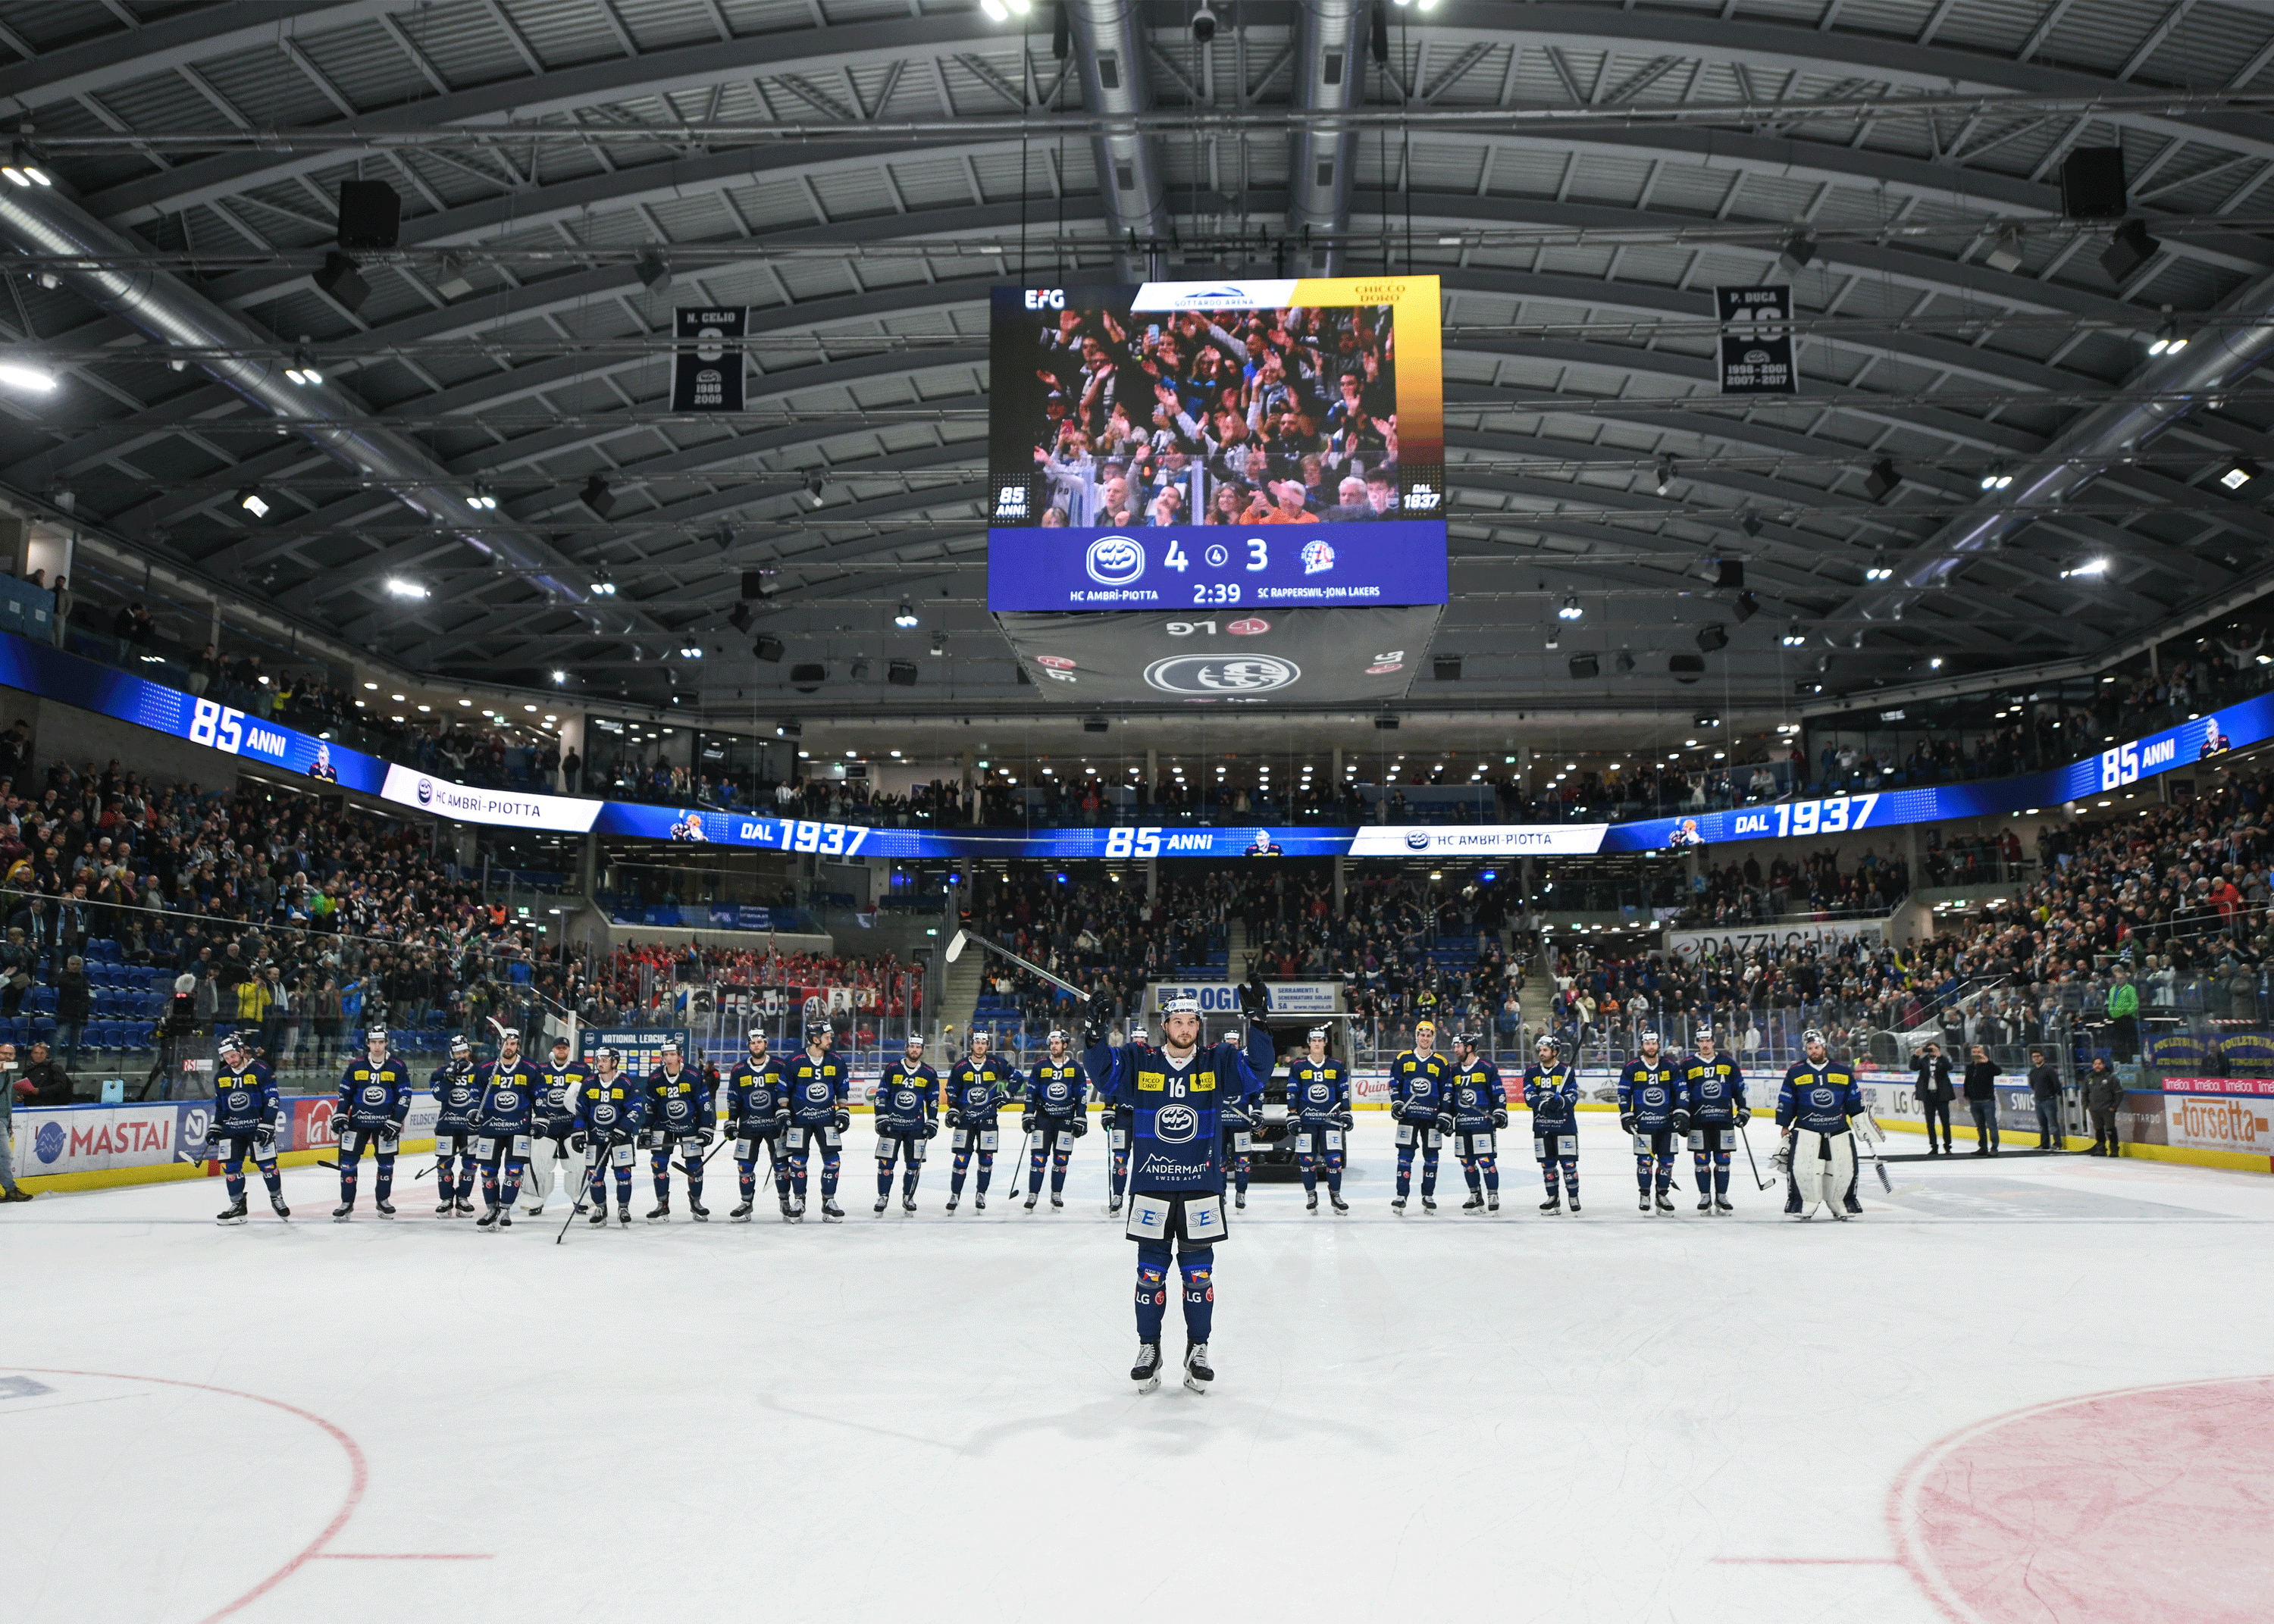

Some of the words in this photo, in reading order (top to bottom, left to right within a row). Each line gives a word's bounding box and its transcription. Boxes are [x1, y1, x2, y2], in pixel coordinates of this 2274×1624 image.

[1025, 289, 1065, 309] EFG
[1225, 298, 1254, 306] ARENA
[1731, 292, 1741, 302] P.
[1745, 292, 1777, 302] DUCA
[687, 313, 697, 323] N.
[702, 311, 735, 323] CELIO
[1727, 374, 1787, 386] 2007-2017
[1413, 484, 1431, 493] DAL
[1000, 487, 1024, 504] 85
[1404, 494, 1440, 508] 1937
[996, 505, 1026, 516] ANNI
[1164, 540, 1189, 572] 4
[1211, 549, 1222, 562] 4
[1246, 538, 1268, 571] 3
[1070, 591, 1084, 601] HC
[1087, 589, 1158, 601] AMBRÌ-PIOTTA
[1193, 584, 1241, 603] 2:39
[1258, 587, 1269, 597] SC
[1270, 587, 1347, 598] RAPPERSWIL-JONA
[1348, 586, 1380, 596] LAKERS
[1166, 621, 1217, 635] LG
[190, 697, 245, 755] 85
[246, 727, 287, 757] ANNI
[2100, 741, 2140, 790] 85
[2142, 740, 2175, 768] ANNI
[436, 788, 446, 806] HC
[447, 791, 541, 818] AMBRÌ-PIOTTA
[1735, 814, 1769, 834] DAL
[1775, 793, 1880, 838] 1937
[741, 823, 773, 842] DAL
[779, 819, 869, 856] 1937
[1104, 827, 1161, 857] 85
[1167, 834, 1212, 851] ANNI
[1437, 834, 1456, 846] HC
[602, 1034, 637, 1044] NATIONAL
[639, 1034, 667, 1044] LEAGUE
[184, 1060, 197, 1071] RSI
[370, 1072, 380, 1084] 91
[815, 1069, 821, 1080] 5
[1052, 1070, 1063, 1081] 37
[1313, 1071, 1323, 1082] 13
[1703, 1066, 1715, 1078] 87
[233, 1077, 243, 1089] 71
[500, 1076, 513, 1088] 27
[553, 1075, 564, 1087] 30
[753, 1075, 765, 1087] 90
[902, 1077, 914, 1089] 43
[974, 1074, 981, 1084] 11
[1460, 1075, 1471, 1087] 77
[1540, 1077, 1552, 1088] 88
[1648, 1073, 1659, 1084] 21
[1818, 1075, 1823, 1086] 1
[667, 1087, 679, 1098] 22
[1168, 1077, 1186, 1098] 16
[600, 1090, 609, 1103] 18
[1893, 1091, 1908, 1114] LG
[2182, 1098, 2256, 1142] torsetta
[70, 1120, 169, 1156] MASTAI
[1145, 1163, 1206, 1174] ANDERMATT
[1136, 1291, 1150, 1304] LG
[1187, 1291, 1201, 1303] LG
